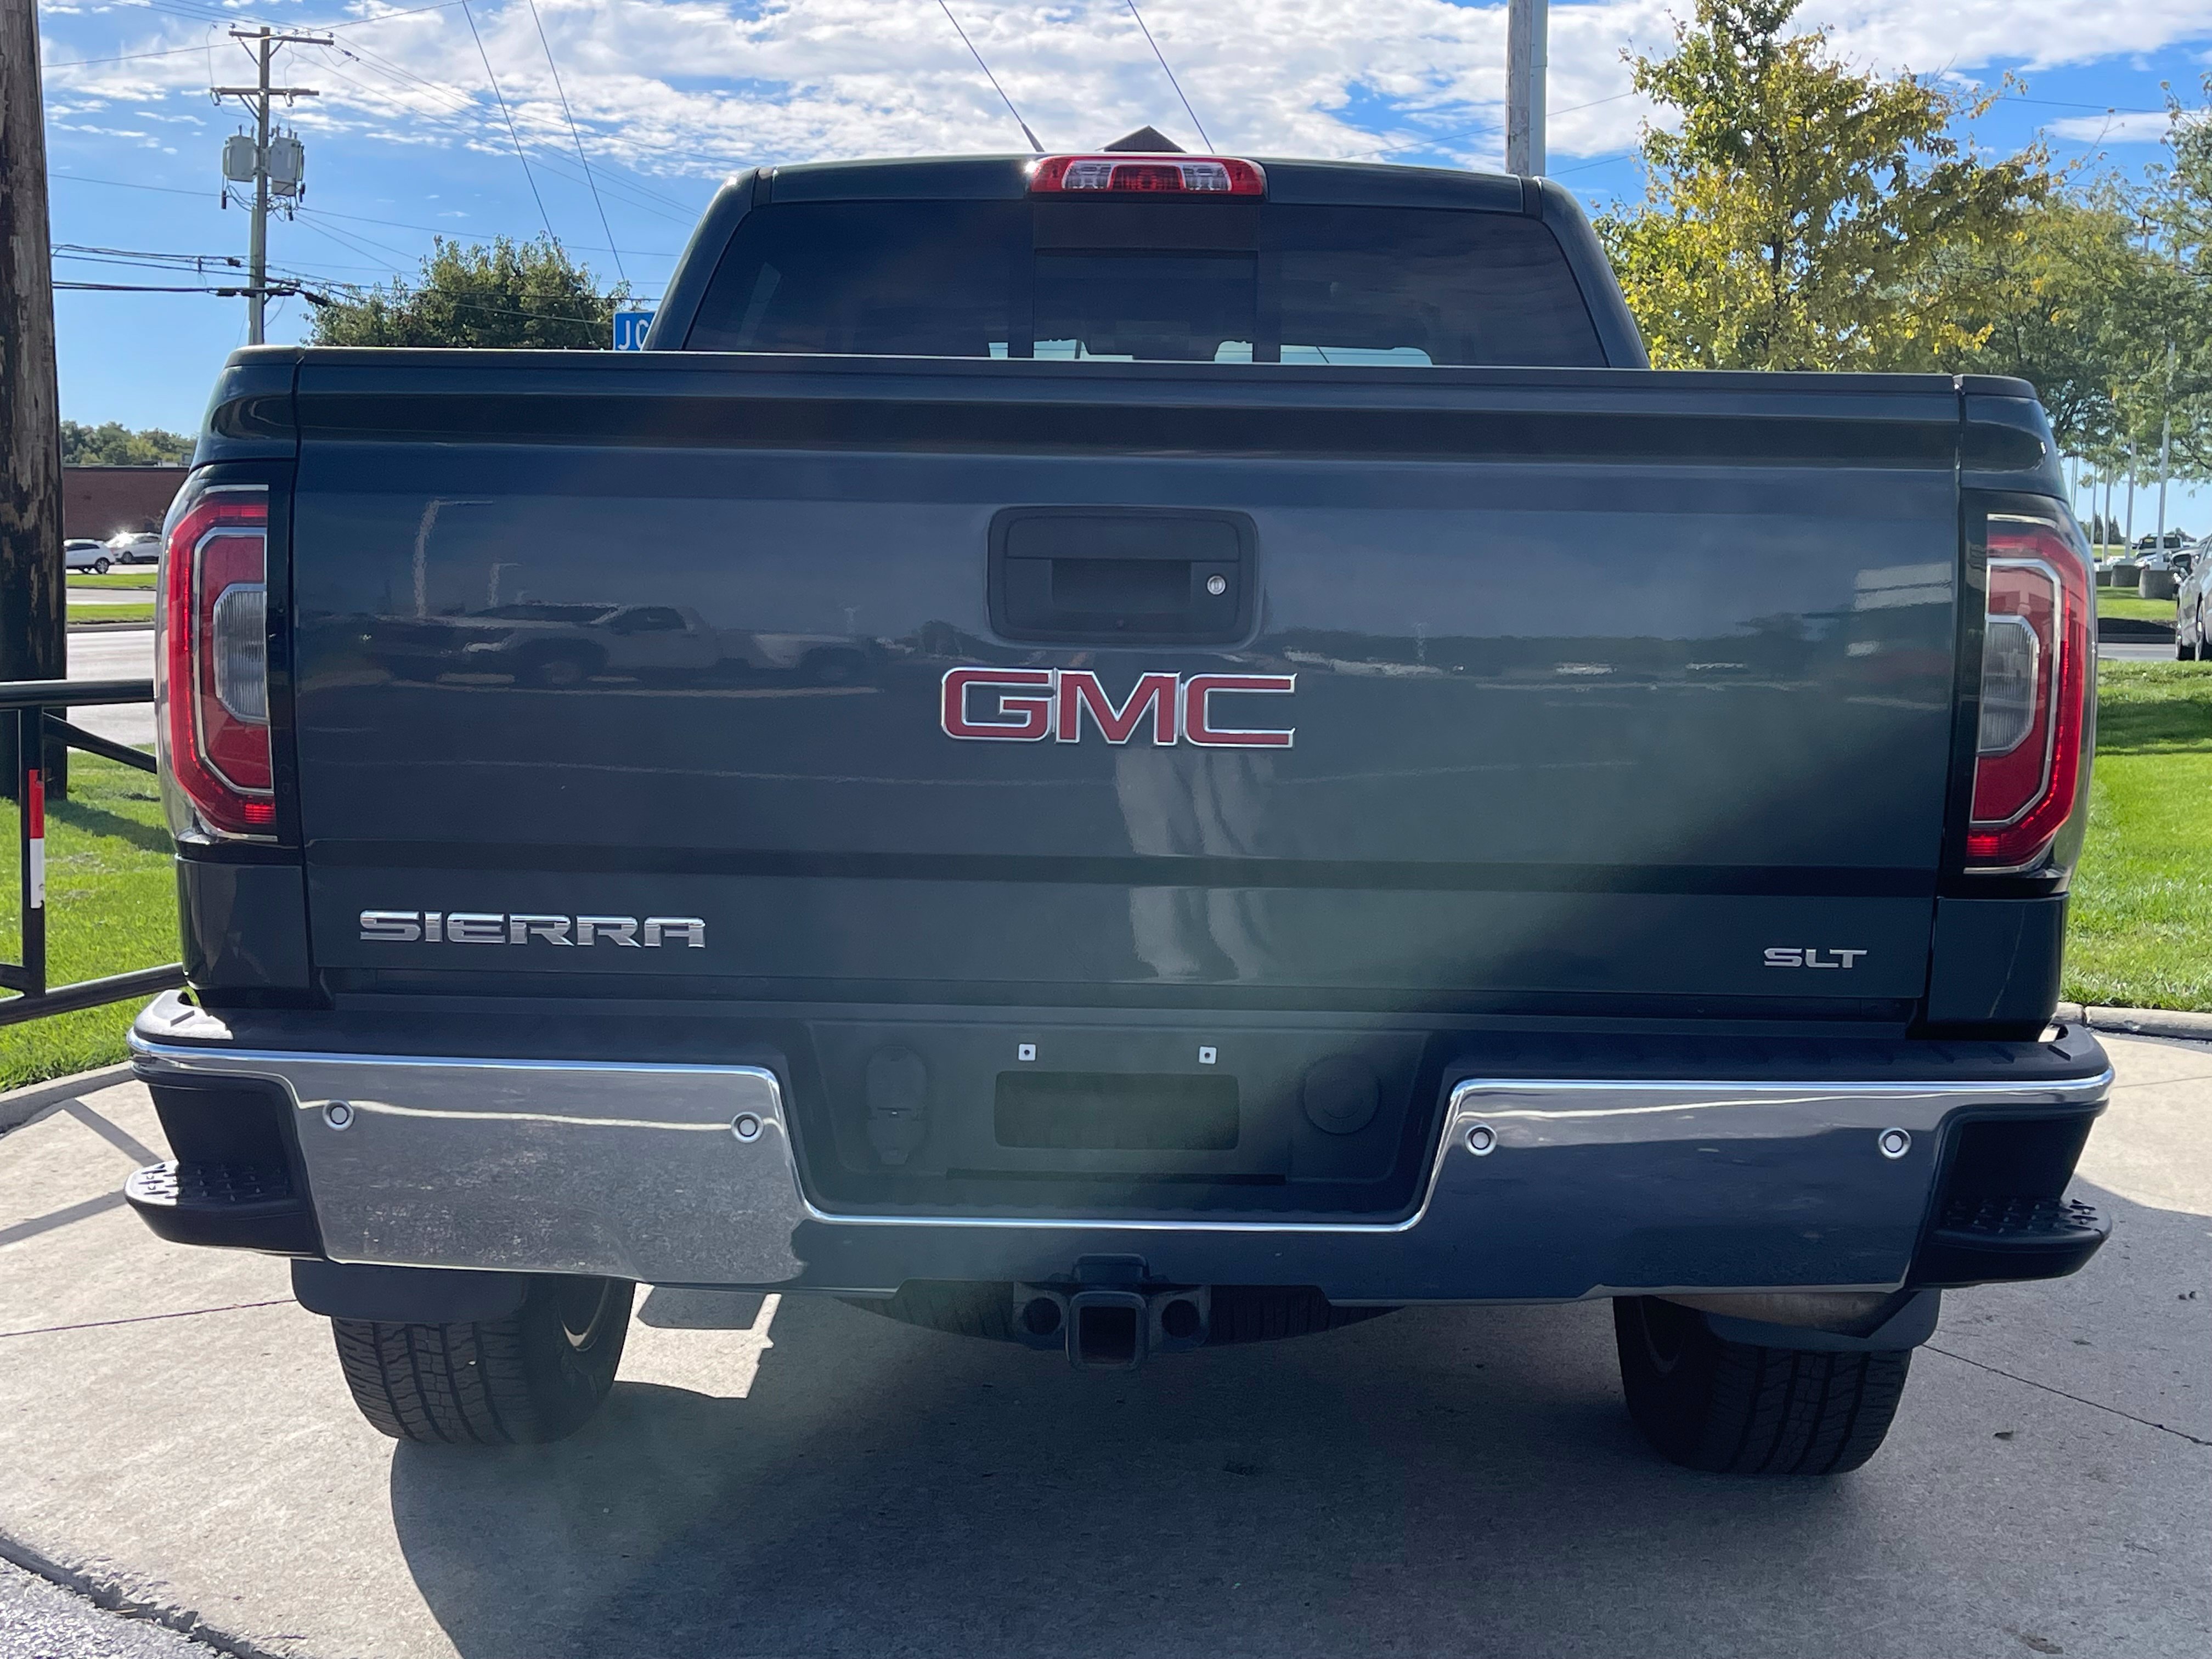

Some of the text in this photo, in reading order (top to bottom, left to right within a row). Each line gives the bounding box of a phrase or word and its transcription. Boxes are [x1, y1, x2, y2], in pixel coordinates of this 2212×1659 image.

[941, 667, 1297, 748] GMC
[360, 910, 706, 947] SIERRA
[1764, 948, 1867, 968] SLT
